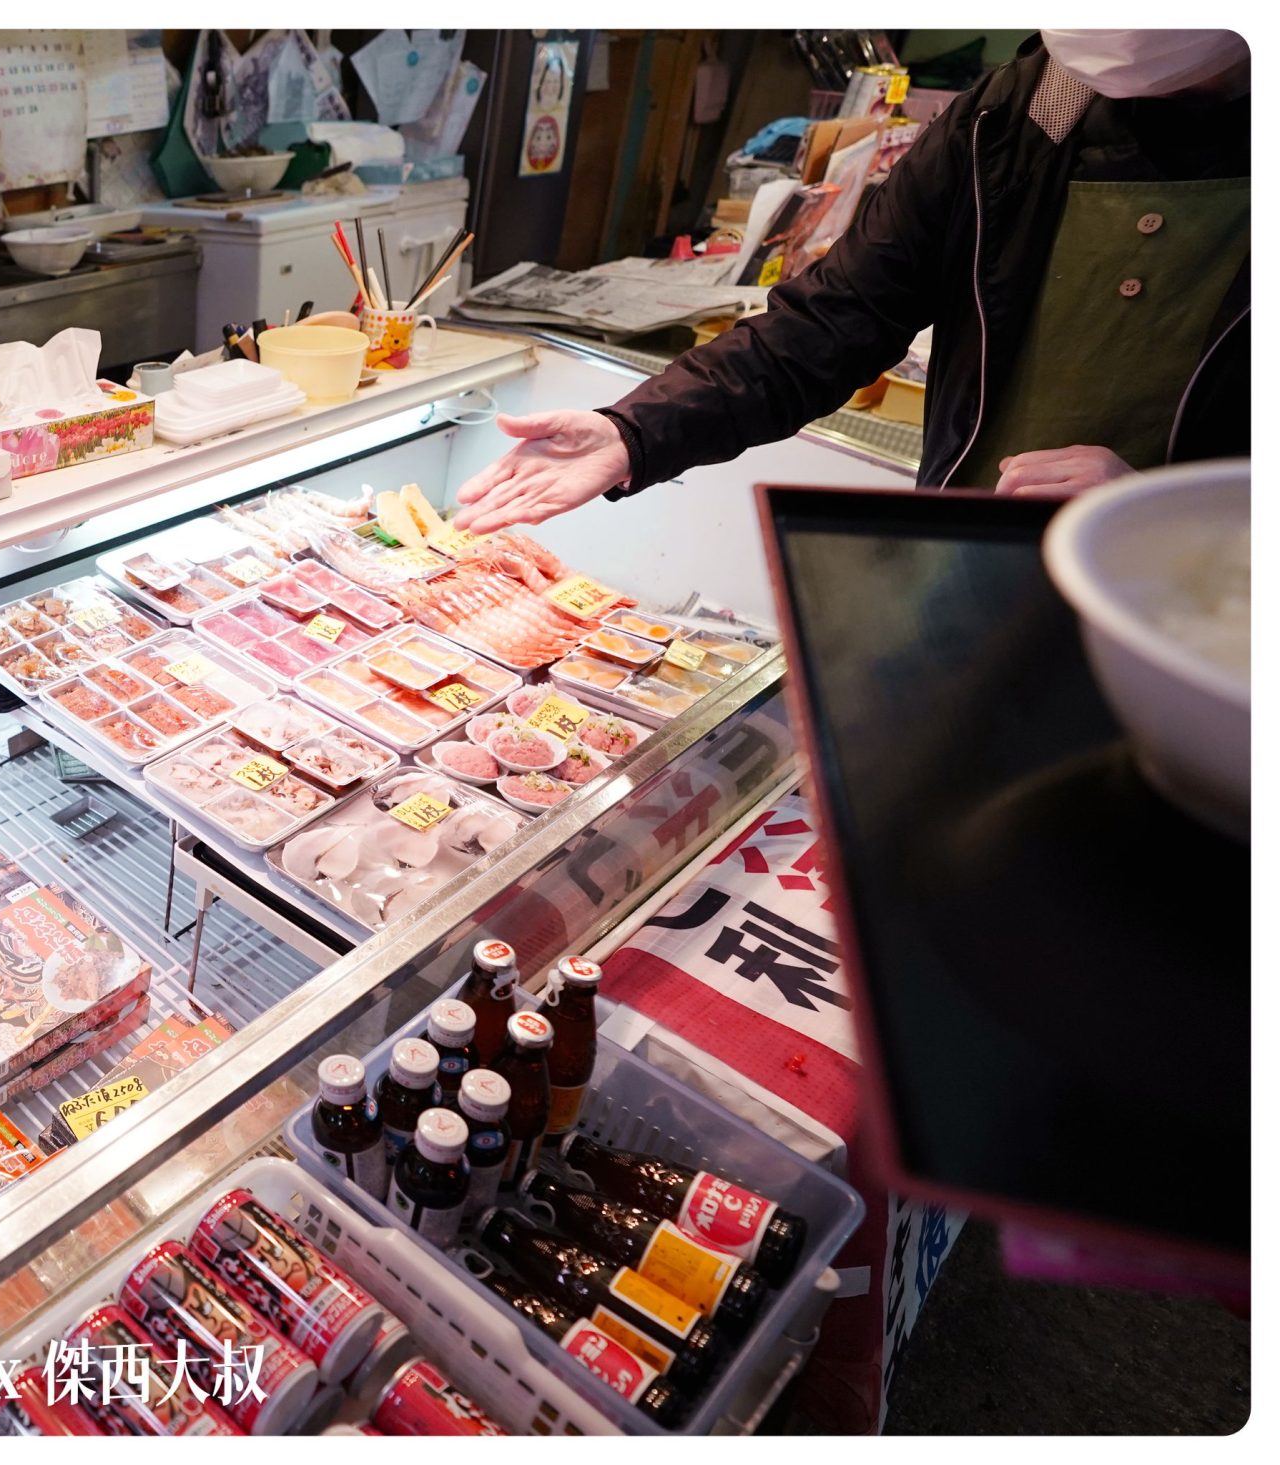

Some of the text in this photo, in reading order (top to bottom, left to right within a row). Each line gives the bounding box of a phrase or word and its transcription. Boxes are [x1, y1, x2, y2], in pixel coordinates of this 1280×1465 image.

[445, 690, 479, 710] 1枚
[546, 714, 584, 740] 1枚
[247, 766, 283, 787] 1枚
[413, 804, 447, 824] 1枚
[722, 1193, 743, 1212] C
